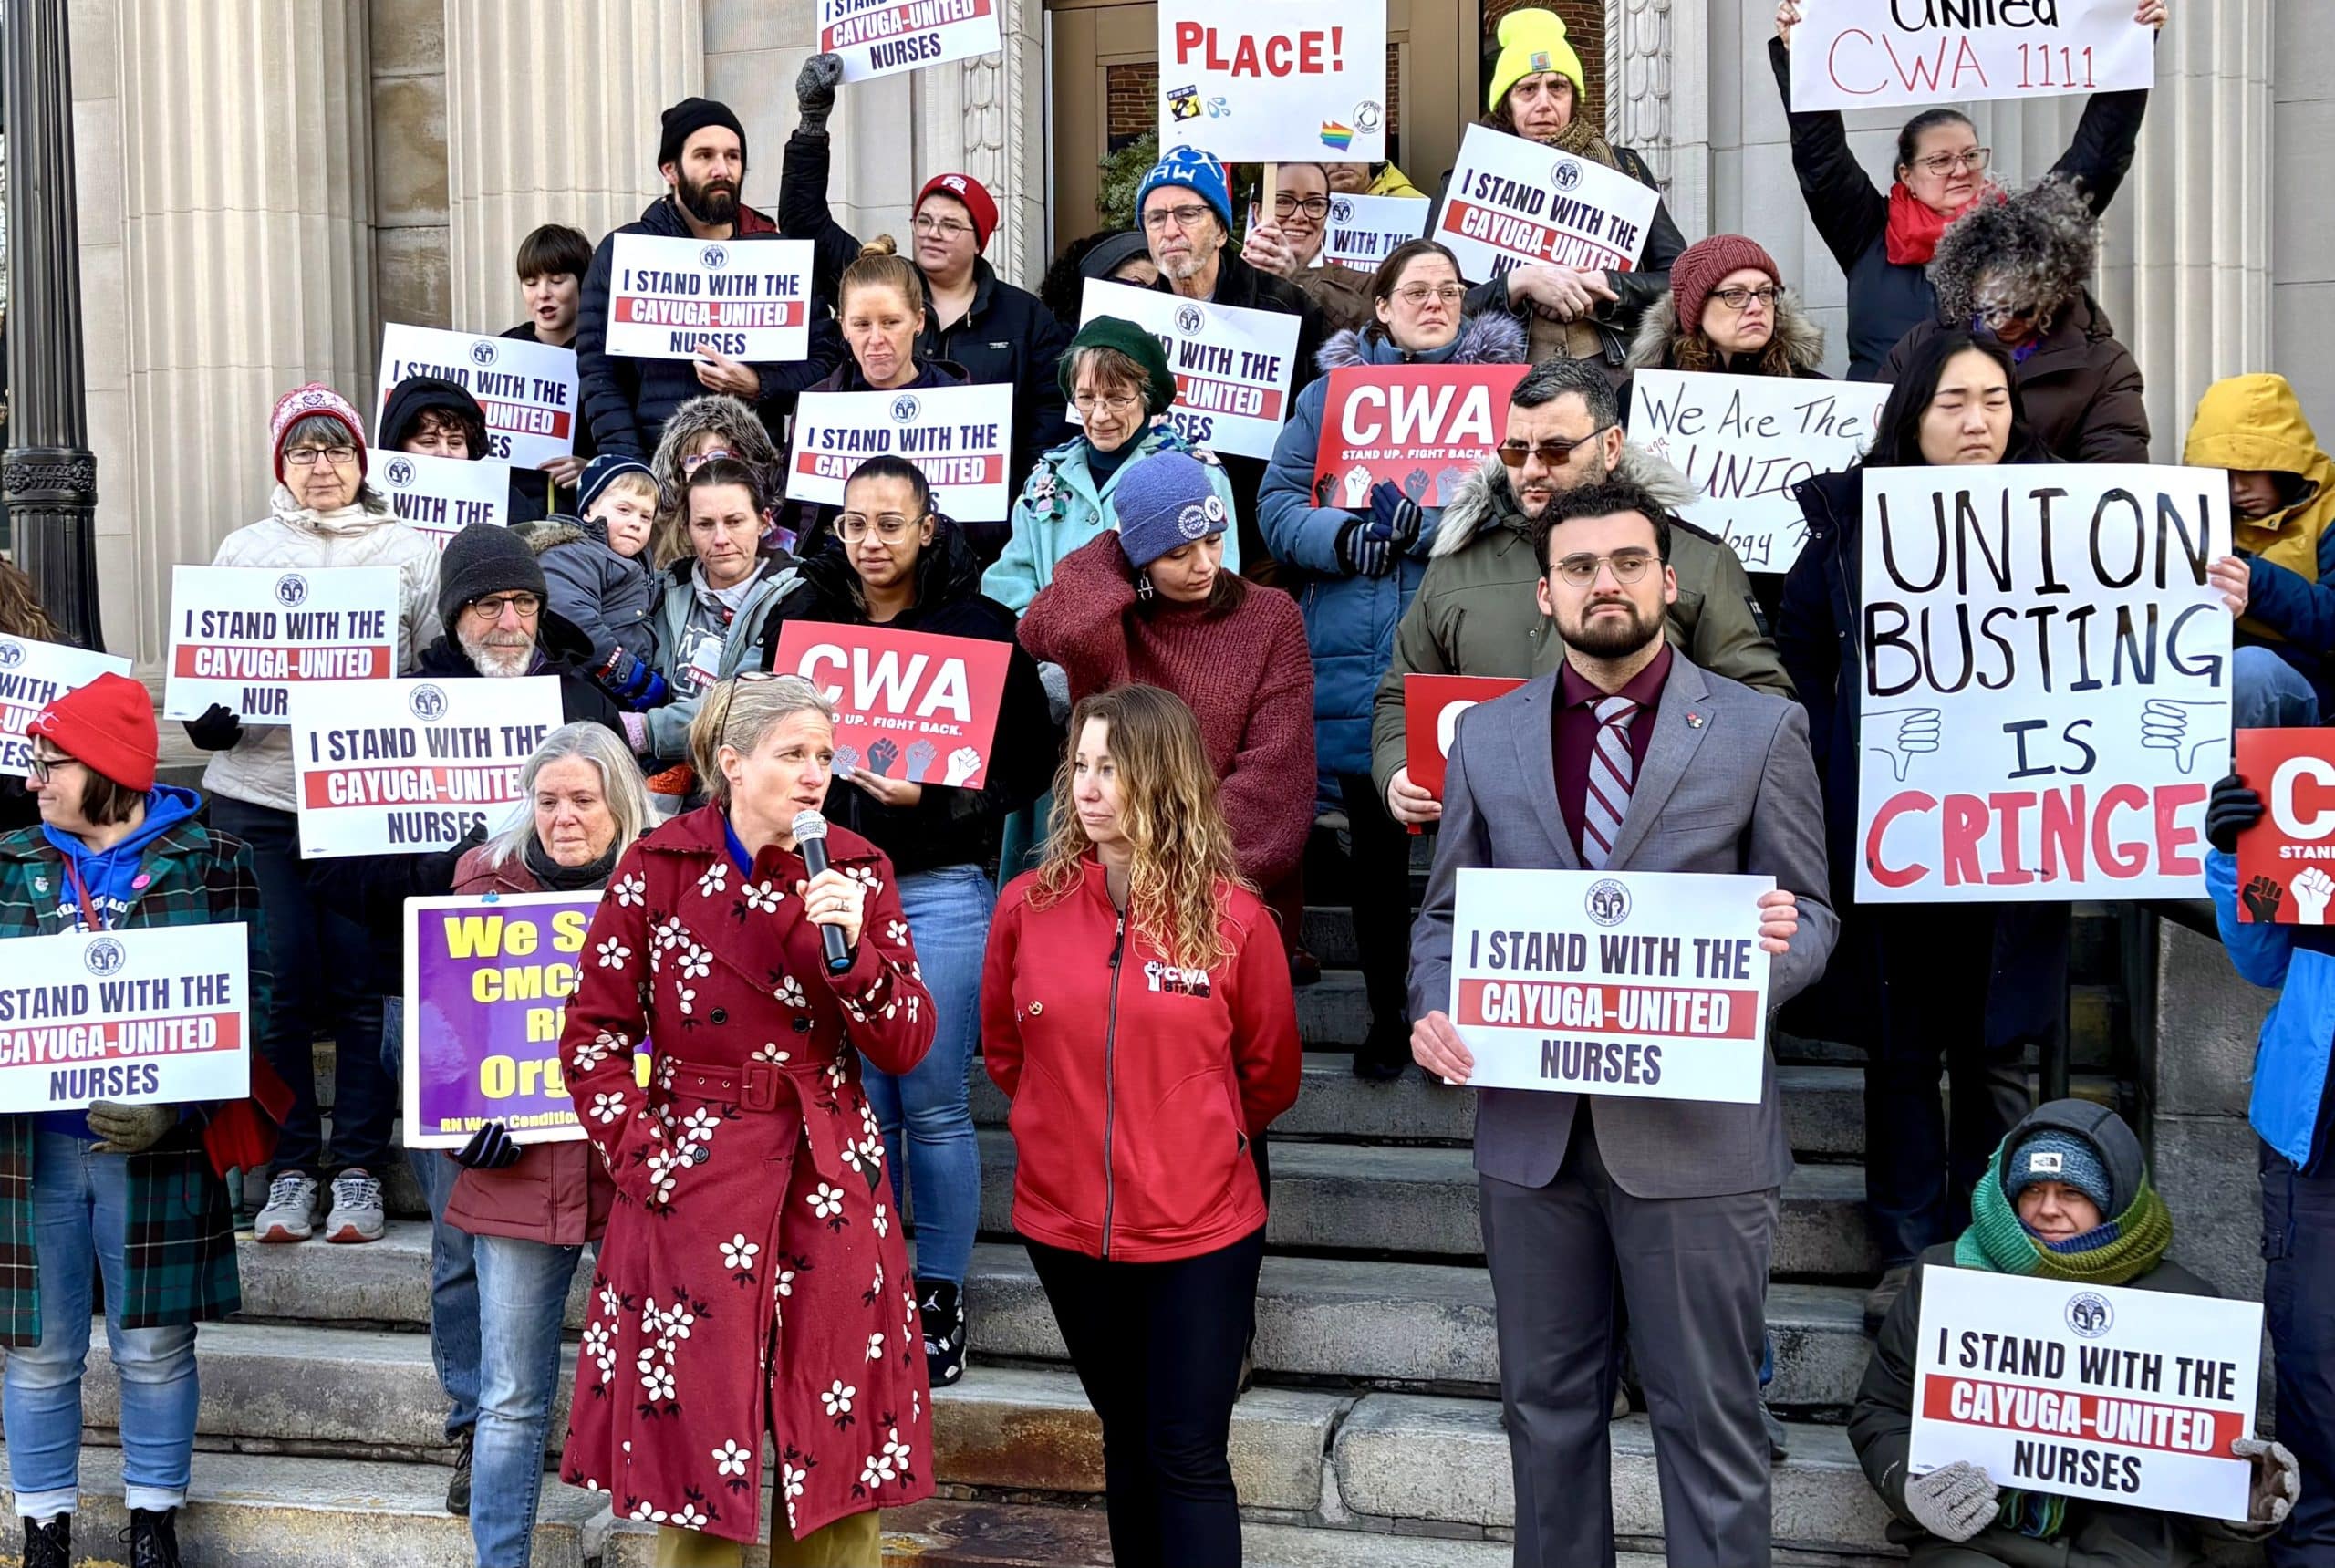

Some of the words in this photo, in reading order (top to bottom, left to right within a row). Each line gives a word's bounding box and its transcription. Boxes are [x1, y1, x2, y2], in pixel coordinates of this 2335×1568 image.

[832, 0, 975, 47] CAYUGA-UNITED
[870, 33, 941, 70] NURSES
[1175, 21, 1344, 78] PLACE!
[1828, 28, 1988, 95] CWA
[2017, 43, 2096, 88] 1111
[1461, 168, 1473, 194] I
[1475, 173, 1545, 215] STAND
[1550, 194, 1604, 236] WITH
[1608, 215, 1638, 252] THE
[1334, 230, 1378, 254] WITH
[1460, 206, 1621, 271] CAYUGA-UNITED
[624, 269, 629, 291] I
[637, 270, 700, 295] STAND
[709, 275, 757, 296] WITH
[765, 275, 799, 296] THE
[631, 298, 788, 326] CAYUGA-UNITED
[393, 360, 400, 382] I
[477, 371, 525, 399] WITH
[534, 379, 567, 405] THE
[1179, 339, 1233, 376] WITH
[1240, 351, 1281, 382] THE
[1341, 385, 1494, 446] CWA
[1641, 382, 1706, 436] We
[1718, 389, 1780, 438] Are
[1794, 395, 1863, 438] The
[807, 428, 815, 447] I
[822, 428, 891, 452] STAND
[899, 427, 952, 452] WITH
[960, 424, 998, 449] THE
[1342, 449, 1380, 461] STAND
[1383, 448, 1404, 460] UP.
[1407, 448, 1445, 460] FIGHT
[1686, 444, 1817, 501] UNIO
[393, 493, 447, 523] WITH
[456, 500, 493, 525] THE
[1878, 487, 2210, 595] UNION
[185, 609, 192, 638] I
[201, 610, 276, 639] STAND
[285, 612, 339, 640] WITH
[348, 610, 385, 639] THE
[194, 647, 373, 679] CAYUGA-UNITED
[1864, 601, 2223, 697] BUSTING
[0, 672, 57, 704] WITH
[242, 687, 288, 716] NUR
[797, 643, 971, 722] CWA
[311, 732, 318, 763] I
[328, 727, 416, 761] STAND
[425, 726, 492, 758] WITH
[845, 714, 868, 726] UP.
[873, 717, 916, 731] FIGHT
[919, 722, 963, 736] BACK.
[2003, 719, 2097, 779] IS
[327, 768, 527, 805] CAYUGA-UNITE
[1865, 783, 2206, 888] CRINGE
[443, 915, 538, 959] We
[1469, 930, 1479, 968] I
[1489, 930, 1587, 972] STAND
[1600, 935, 1680, 977] WITH
[1693, 938, 1751, 979] THE
[0, 984, 88, 1022] STAND
[100, 978, 170, 1013] WITH
[181, 973, 231, 1008] THE
[1165, 966, 1210, 986] CWA
[1481, 982, 1730, 1034] CAYUGA-UNITED
[0, 1016, 218, 1064] CAYUGA-UNITED
[1541, 1040, 1662, 1085] NURSES
[49, 1063, 159, 1101] NURSES
[440, 1118, 462, 1132] RN
[1938, 1328, 1947, 1366] I
[1959, 1331, 2065, 1379] STAND
[2079, 1345, 2163, 1393] WITH
[2176, 1356, 2236, 1401] THE
[1950, 1380, 2215, 1452] CAYUGA-UNITED
[2013, 1440, 2142, 1494] NURSES
